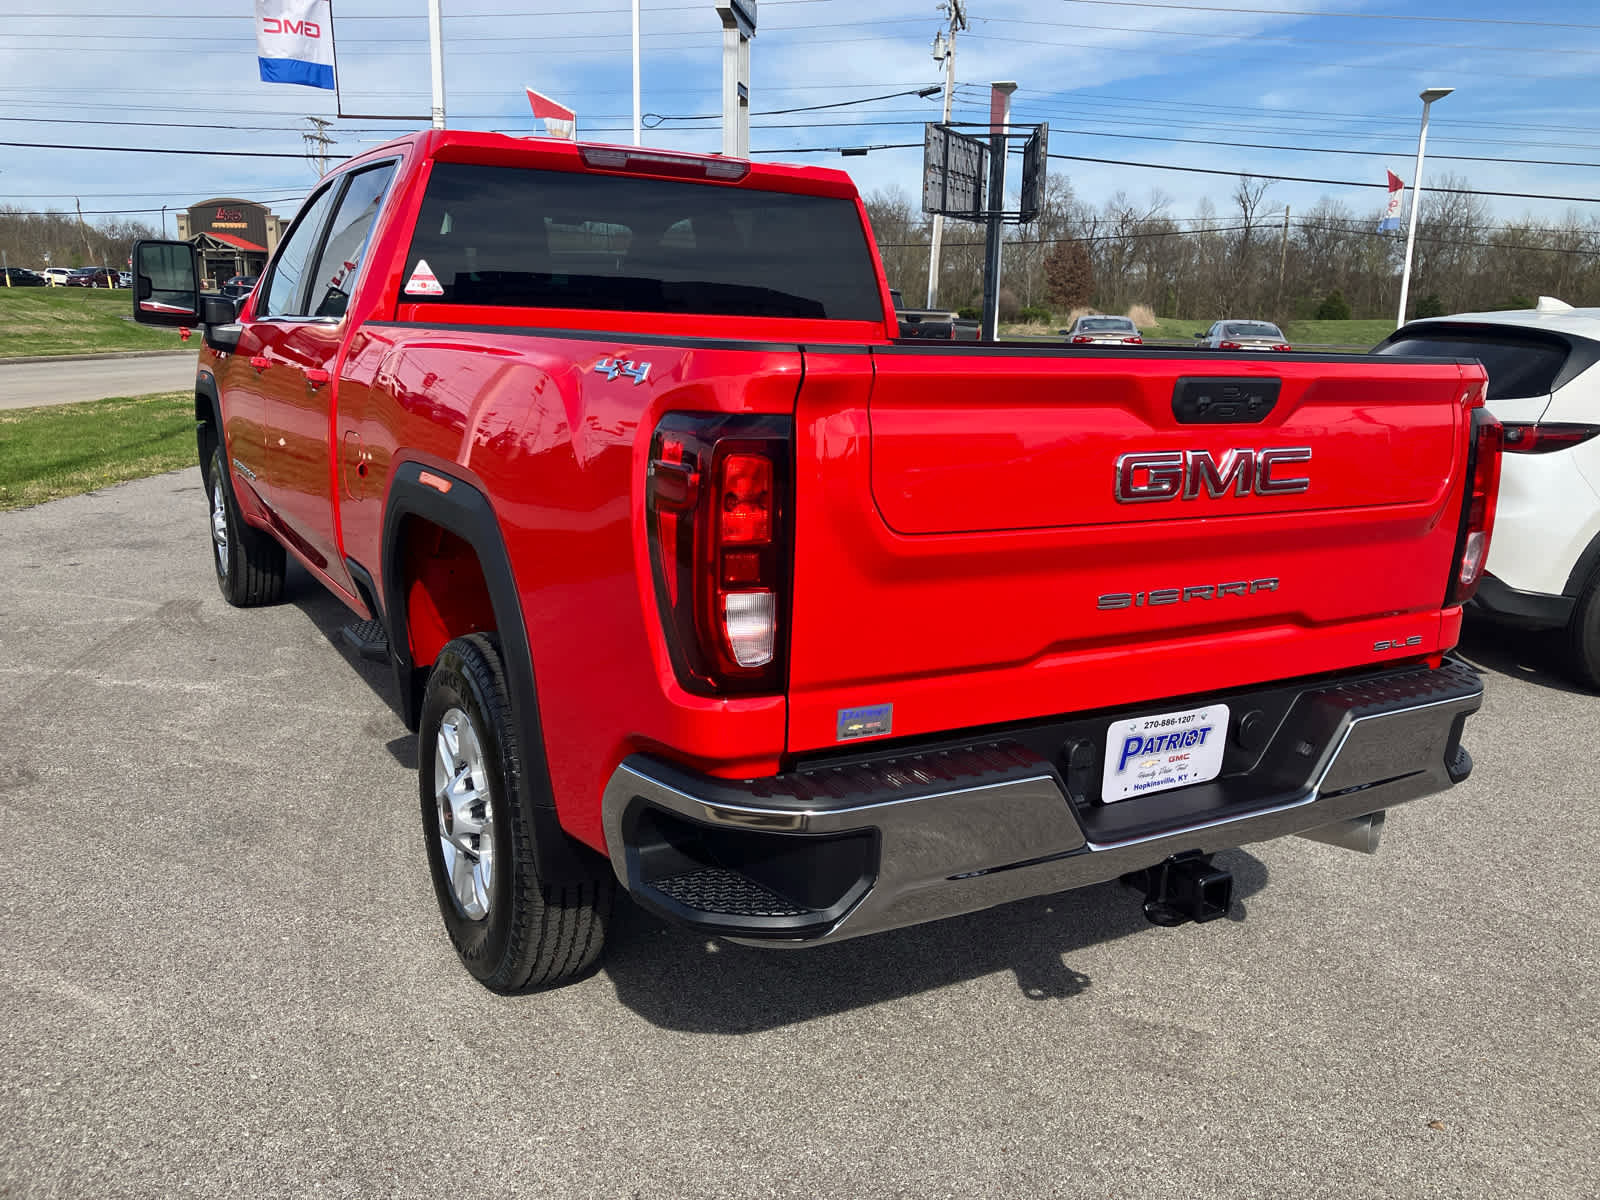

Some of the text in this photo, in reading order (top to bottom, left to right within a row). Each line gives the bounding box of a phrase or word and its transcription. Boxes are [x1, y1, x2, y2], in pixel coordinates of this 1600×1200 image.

[1115, 447, 1312, 504] GMC
[1096, 577, 1280, 610] SIERRA
[1143, 714, 1196, 730] 270-886-1207
[1118, 727, 1212, 772] PATRIOT
[1168, 753, 1191, 763] GMC
[1133, 773, 1189, 791] Hopkinsville, KY
